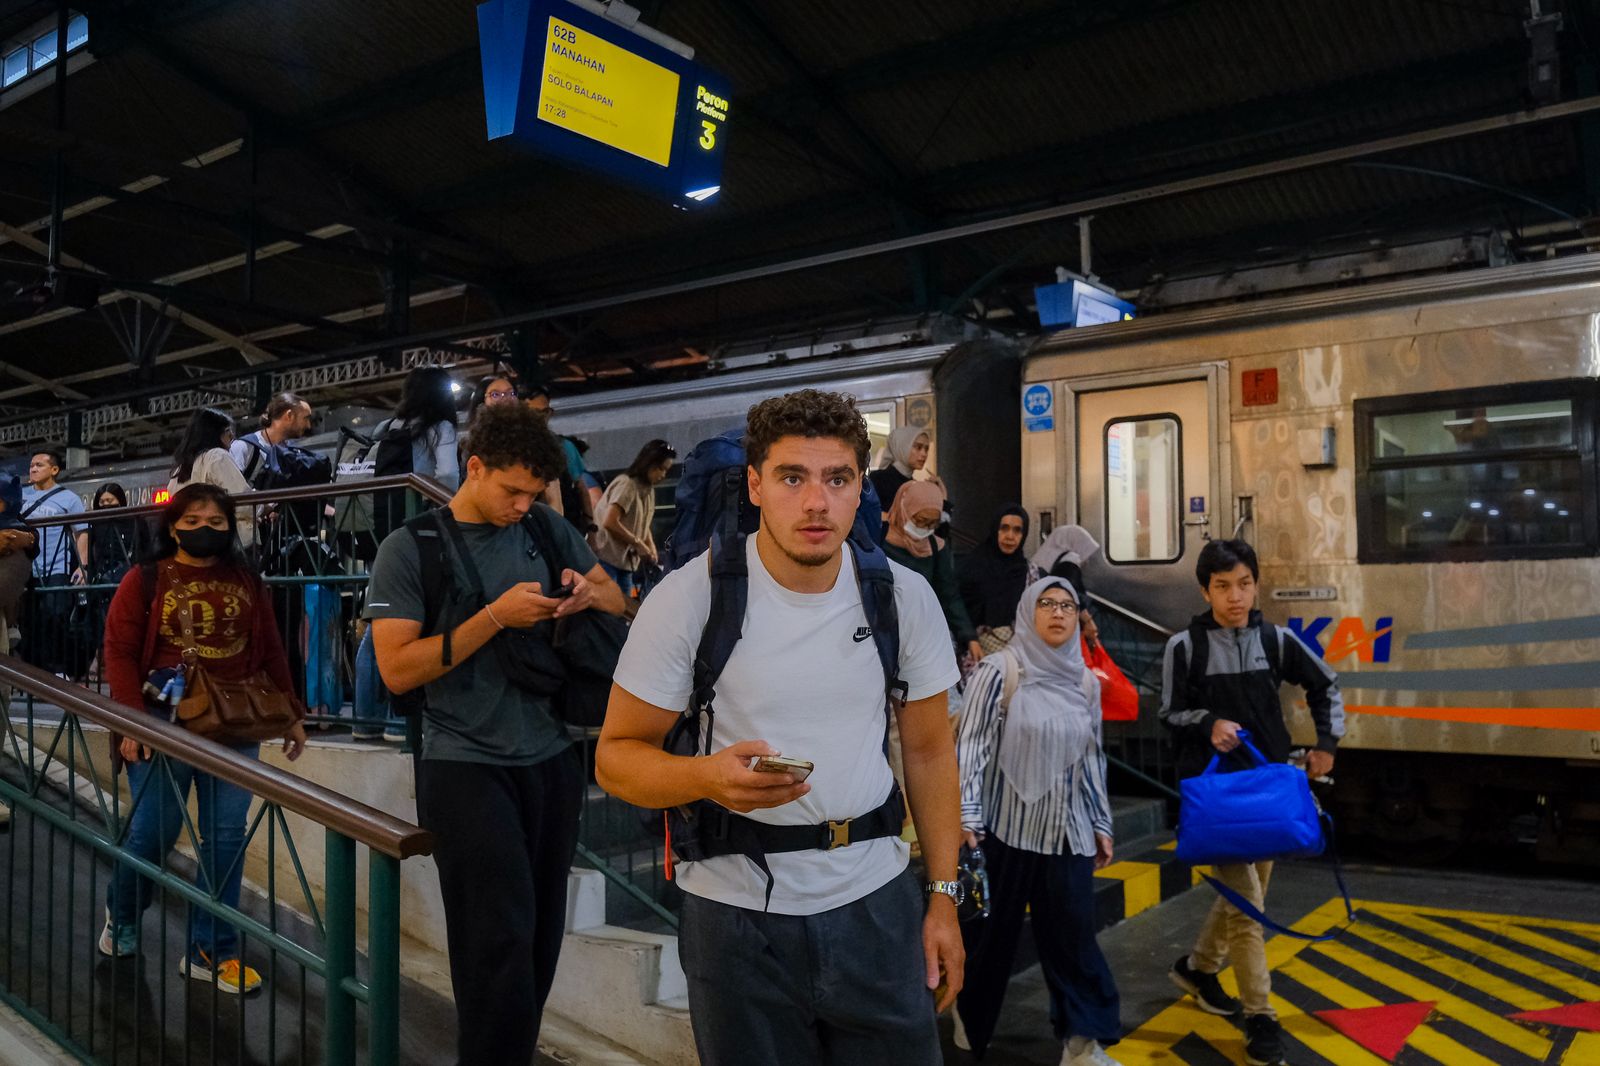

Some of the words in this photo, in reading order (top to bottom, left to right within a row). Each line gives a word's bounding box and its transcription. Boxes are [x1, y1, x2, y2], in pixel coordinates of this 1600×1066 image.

[553, 24, 577, 45] 62B
[551, 42, 606, 74] MANAHAN
[547, 73, 573, 91] SOLO
[574, 84, 614, 108] BALAPAN
[696, 85, 729, 112] Peron
[544, 103, 567, 119] 17:28
[696, 101, 727, 122] Platform
[699, 119, 717, 150] 3
[856, 626, 873, 636] NIKE
[1287, 616, 1393, 664] KAI
